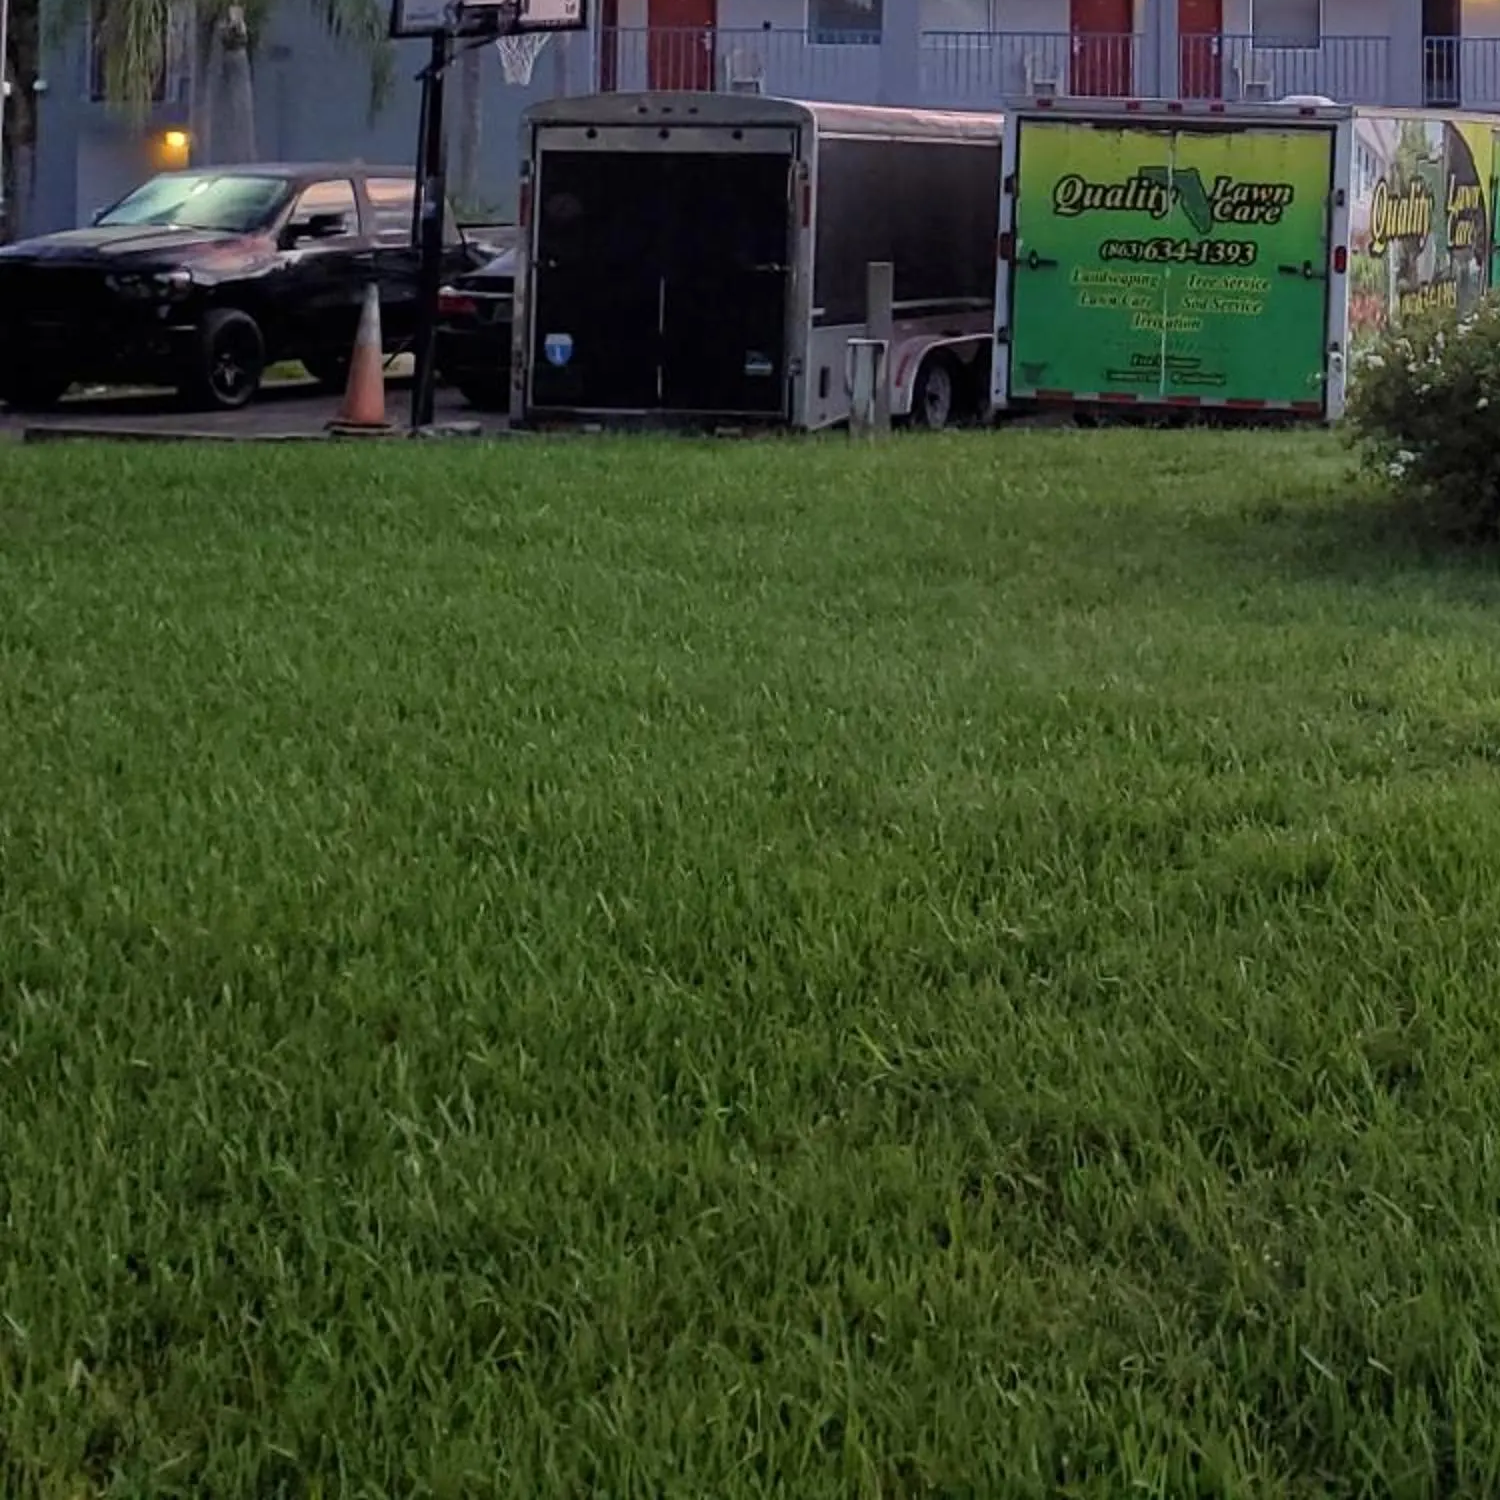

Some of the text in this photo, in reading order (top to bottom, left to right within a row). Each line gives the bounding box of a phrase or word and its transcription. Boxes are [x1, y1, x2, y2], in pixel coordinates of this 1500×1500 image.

[1055, 175, 1292, 217] Quality Lawn
[1212, 199, 1281, 223] Care
[1370, 180, 1433, 253] Quality
